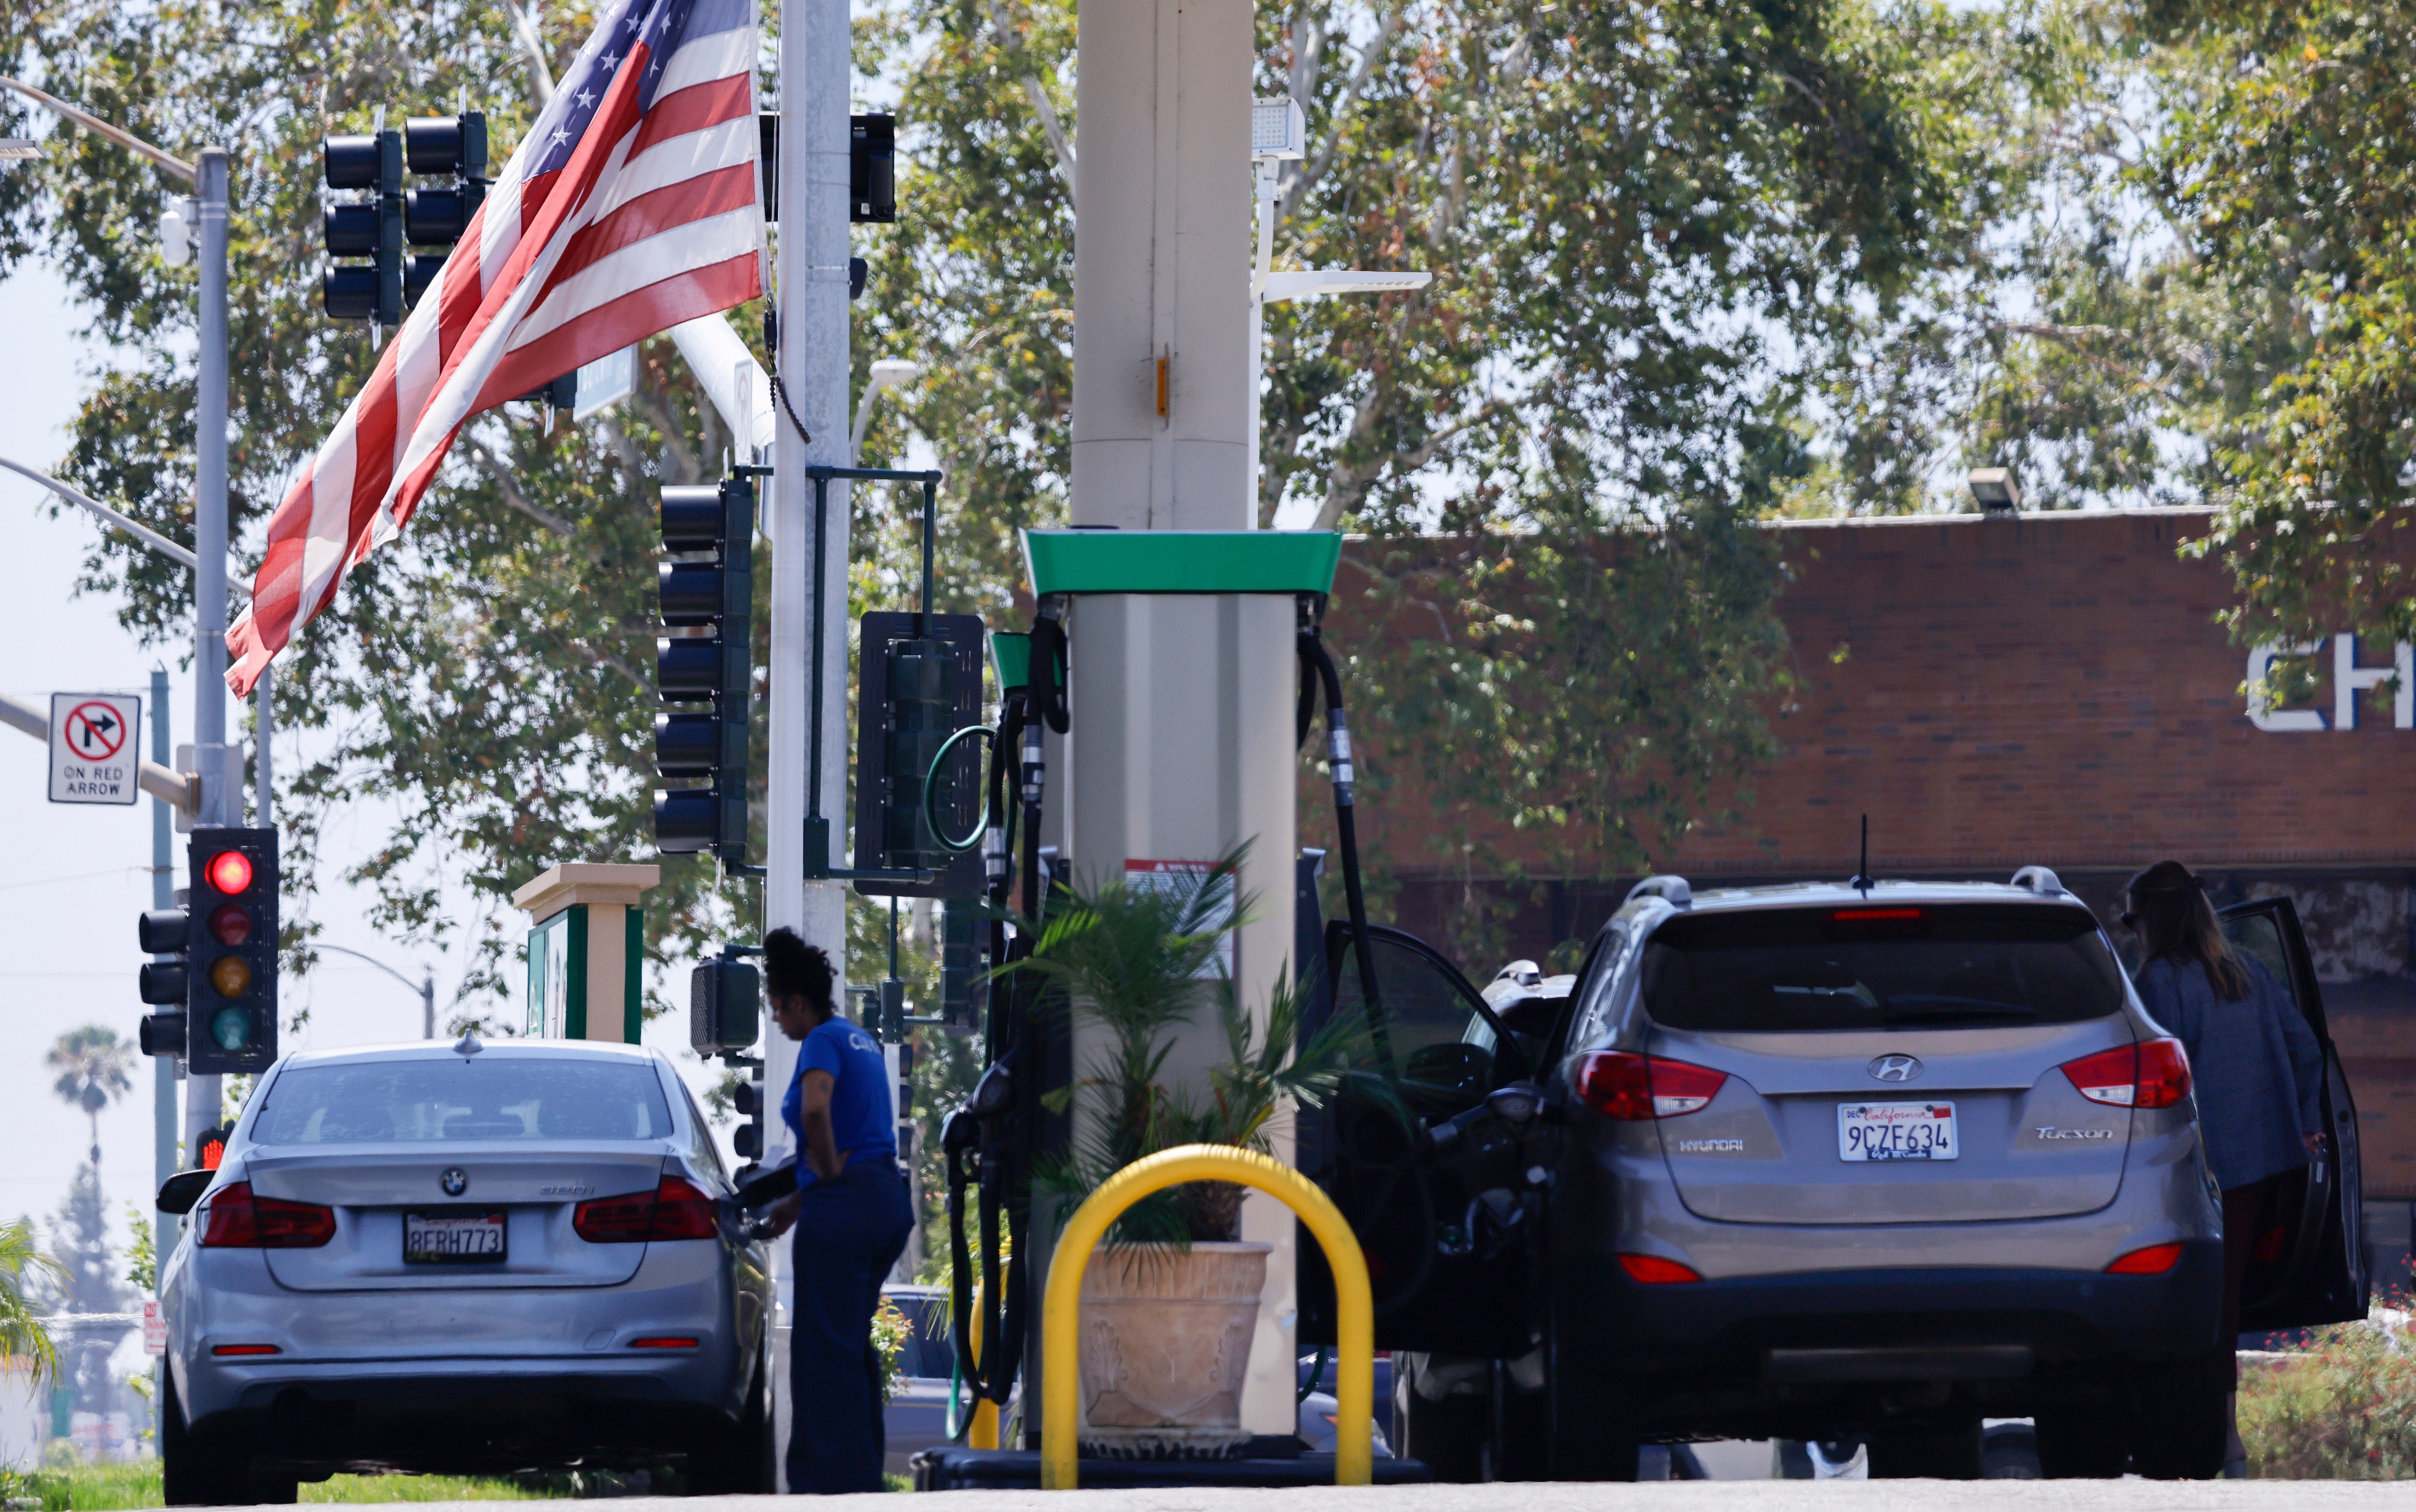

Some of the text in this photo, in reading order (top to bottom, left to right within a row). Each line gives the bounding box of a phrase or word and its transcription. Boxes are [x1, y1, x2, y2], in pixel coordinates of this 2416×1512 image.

[2247, 632, 2416, 732] CH
[64, 765, 123, 780] ON RED
[66, 782, 120, 795] ARROW
[1864, 1108, 1934, 1123] California
[1848, 1123, 1948, 1152] 9CZF634
[1680, 1139, 1743, 1152] HYUNDAI
[145, 1321, 166, 1329] PARKIN
